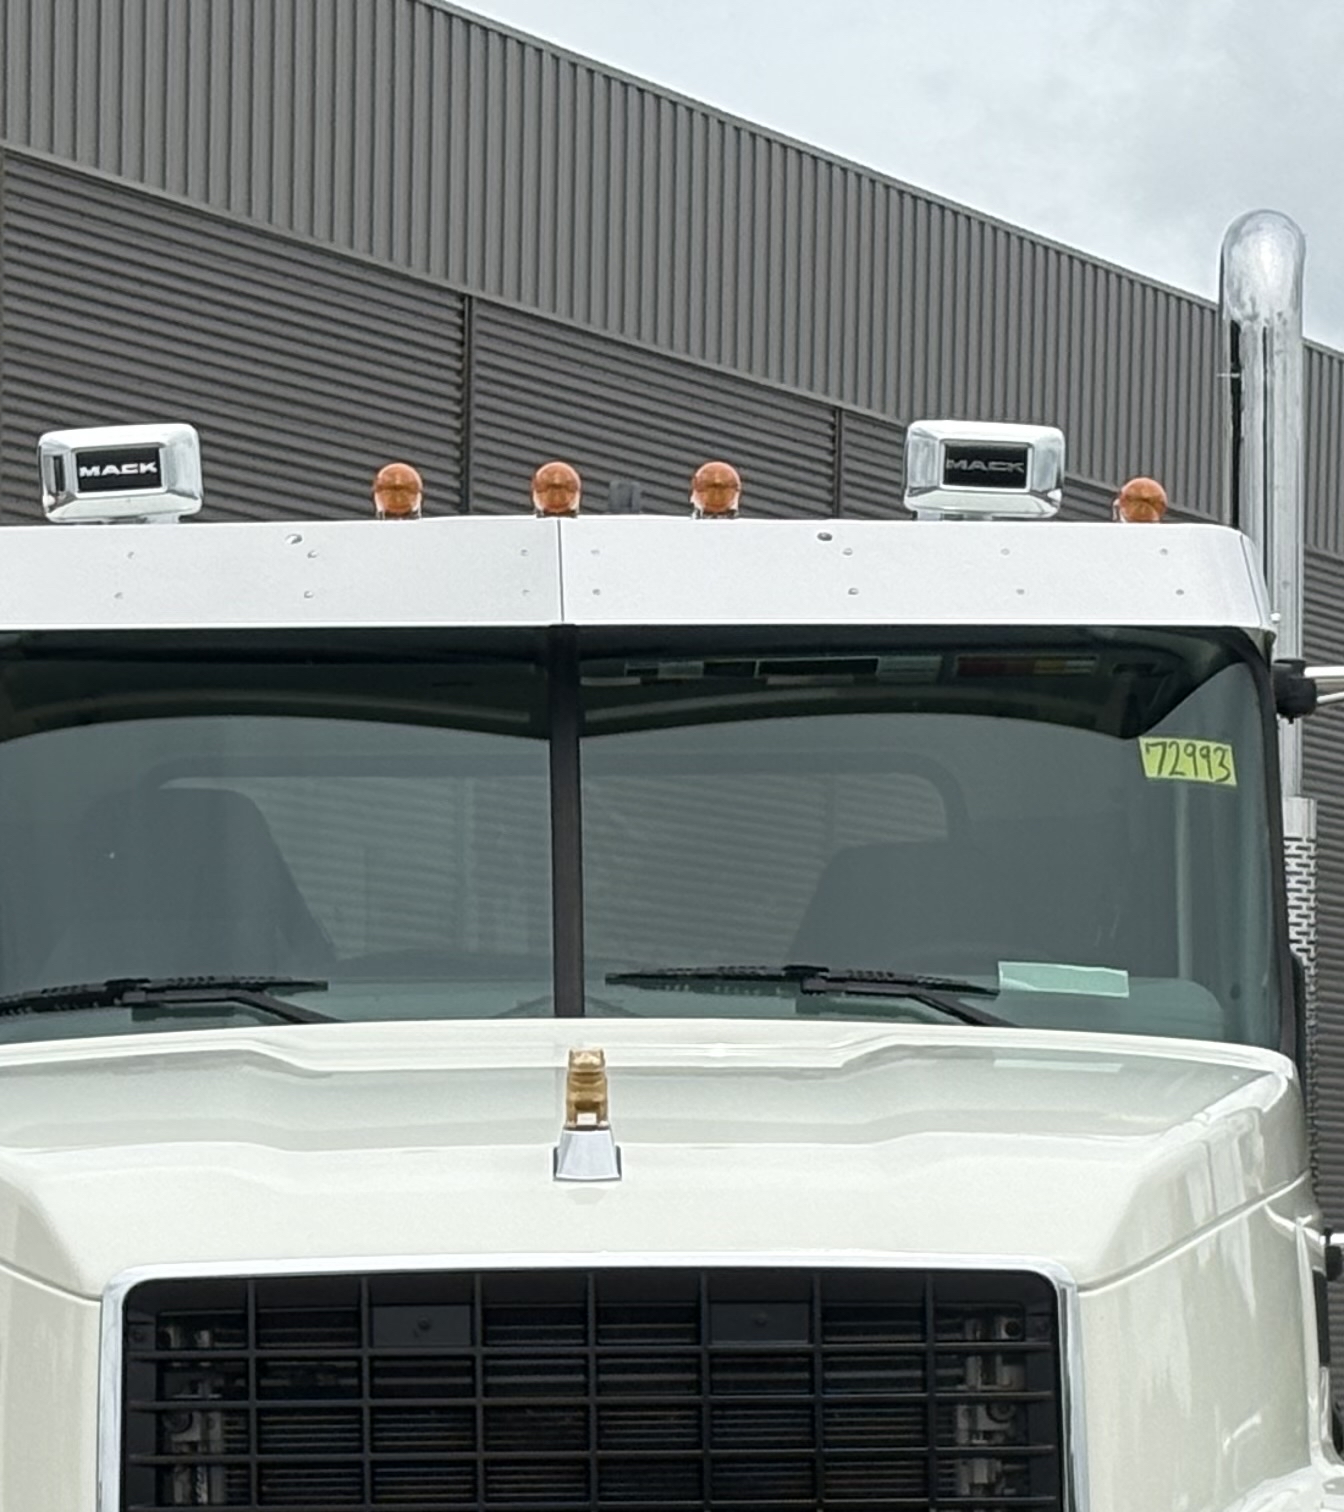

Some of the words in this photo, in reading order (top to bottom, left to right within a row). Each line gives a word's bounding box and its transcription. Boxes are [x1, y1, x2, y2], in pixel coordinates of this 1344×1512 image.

[79, 461, 158, 477] MACK
[945, 459, 1024, 473] MACK
[1145, 741, 1232, 783] 72993
